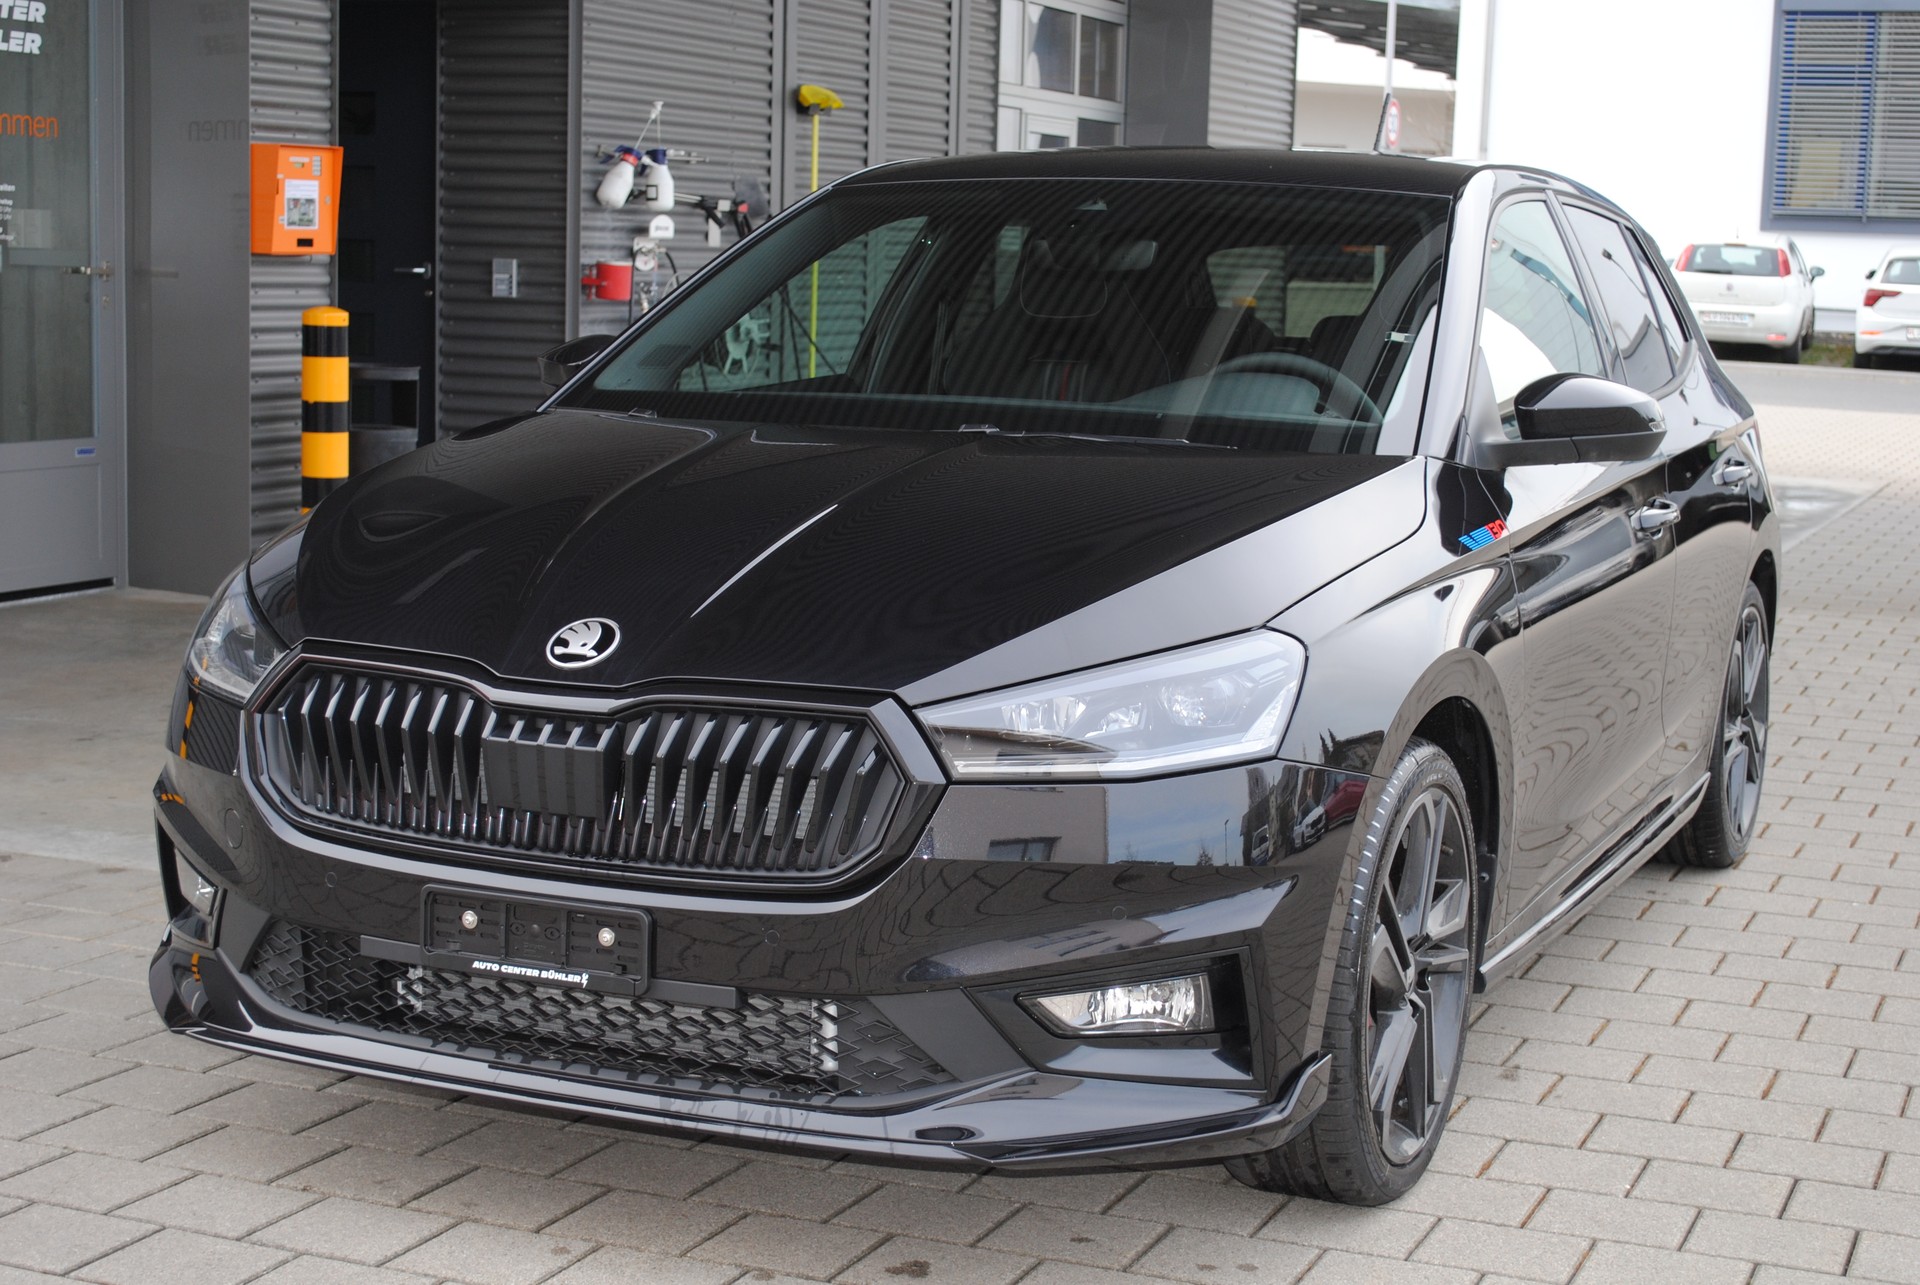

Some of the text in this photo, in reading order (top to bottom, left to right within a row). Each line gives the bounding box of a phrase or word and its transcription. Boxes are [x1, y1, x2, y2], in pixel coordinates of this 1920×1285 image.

[472, 960, 581, 983] AUTO CENTER BÜHLER
